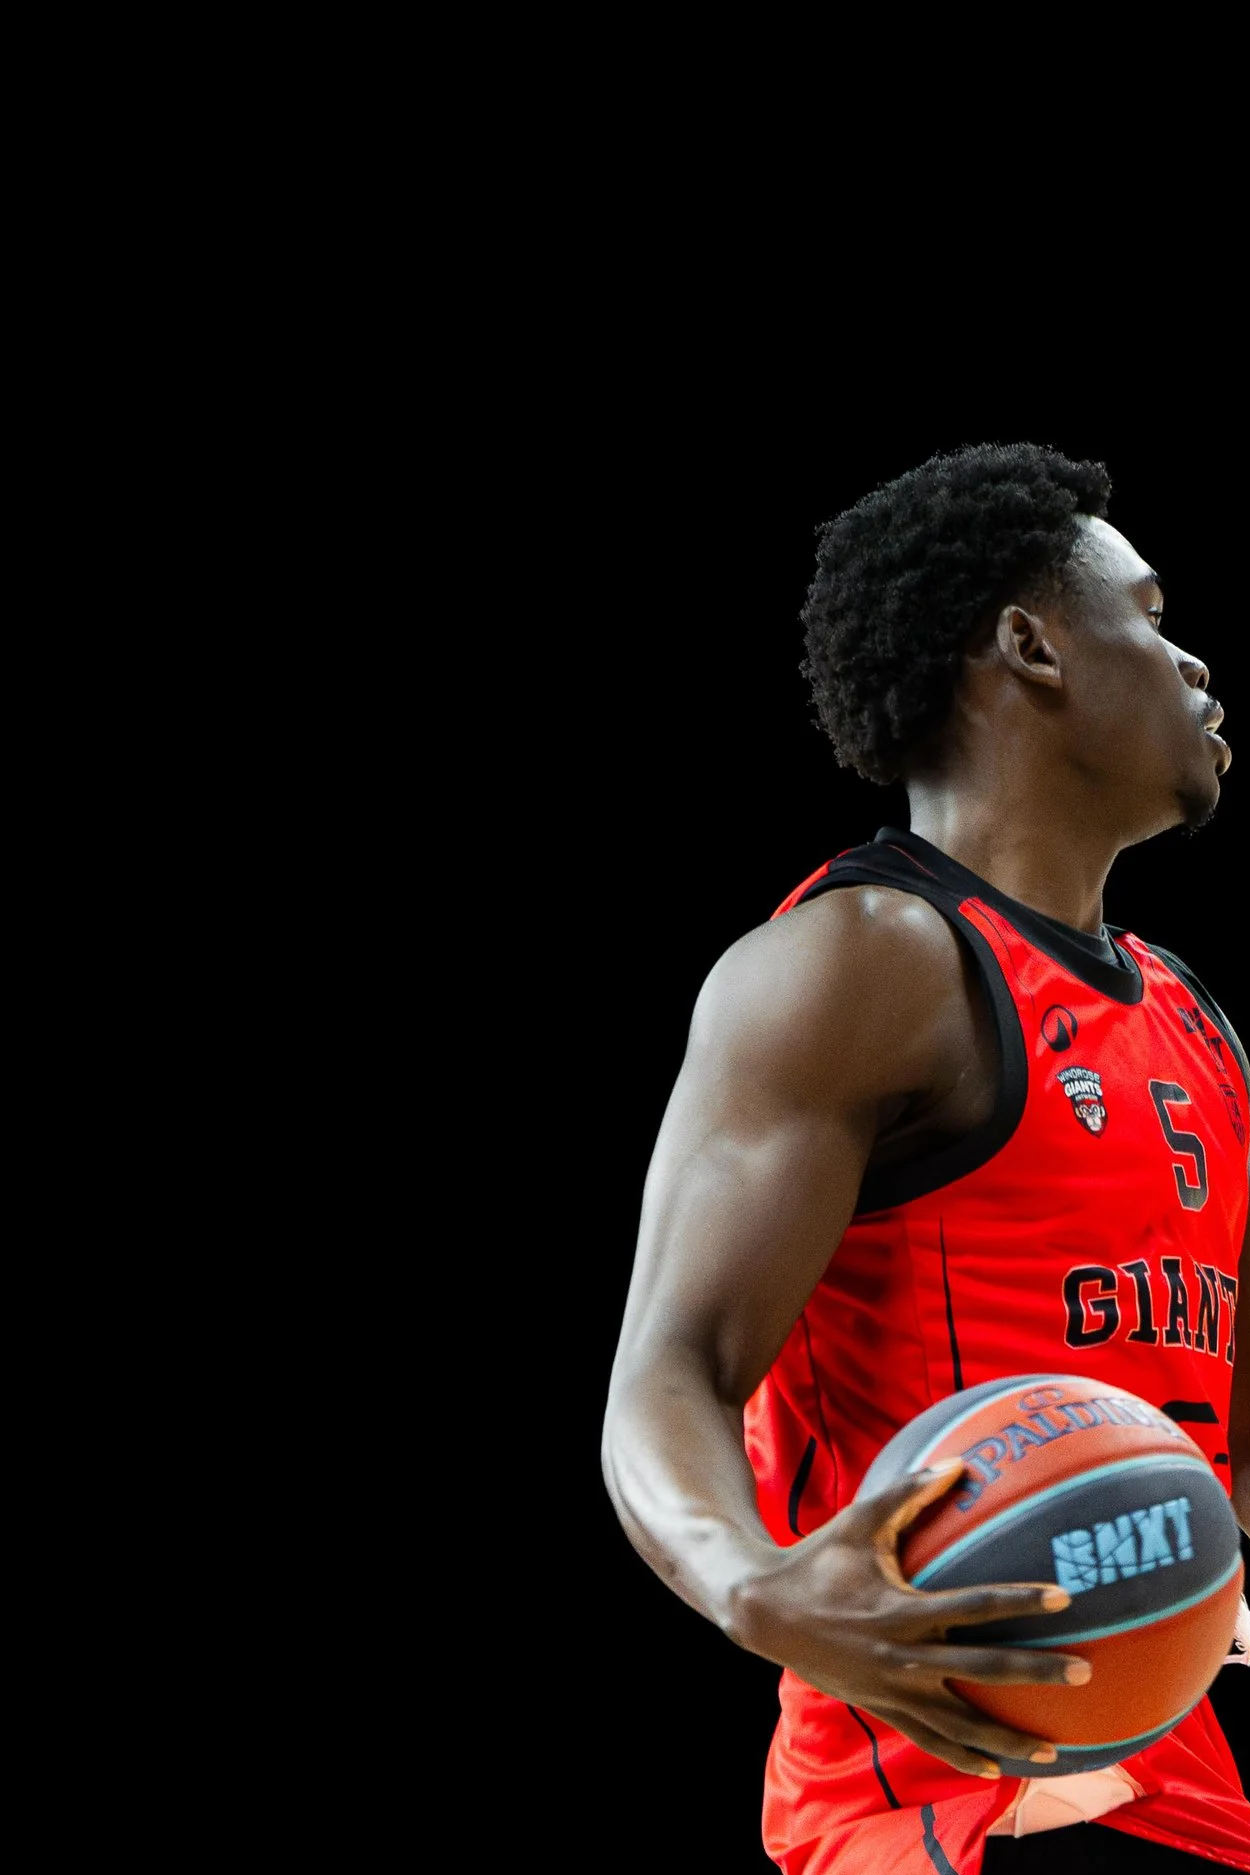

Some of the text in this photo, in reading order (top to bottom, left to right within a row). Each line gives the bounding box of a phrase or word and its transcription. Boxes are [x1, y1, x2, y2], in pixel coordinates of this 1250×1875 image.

[1064, 1080, 1103, 1097] GIANTS
[1148, 1079, 1208, 1211] 5
[955, 1397, 1187, 1512] PALDIN
[1052, 1497, 1194, 1594] BNXT
